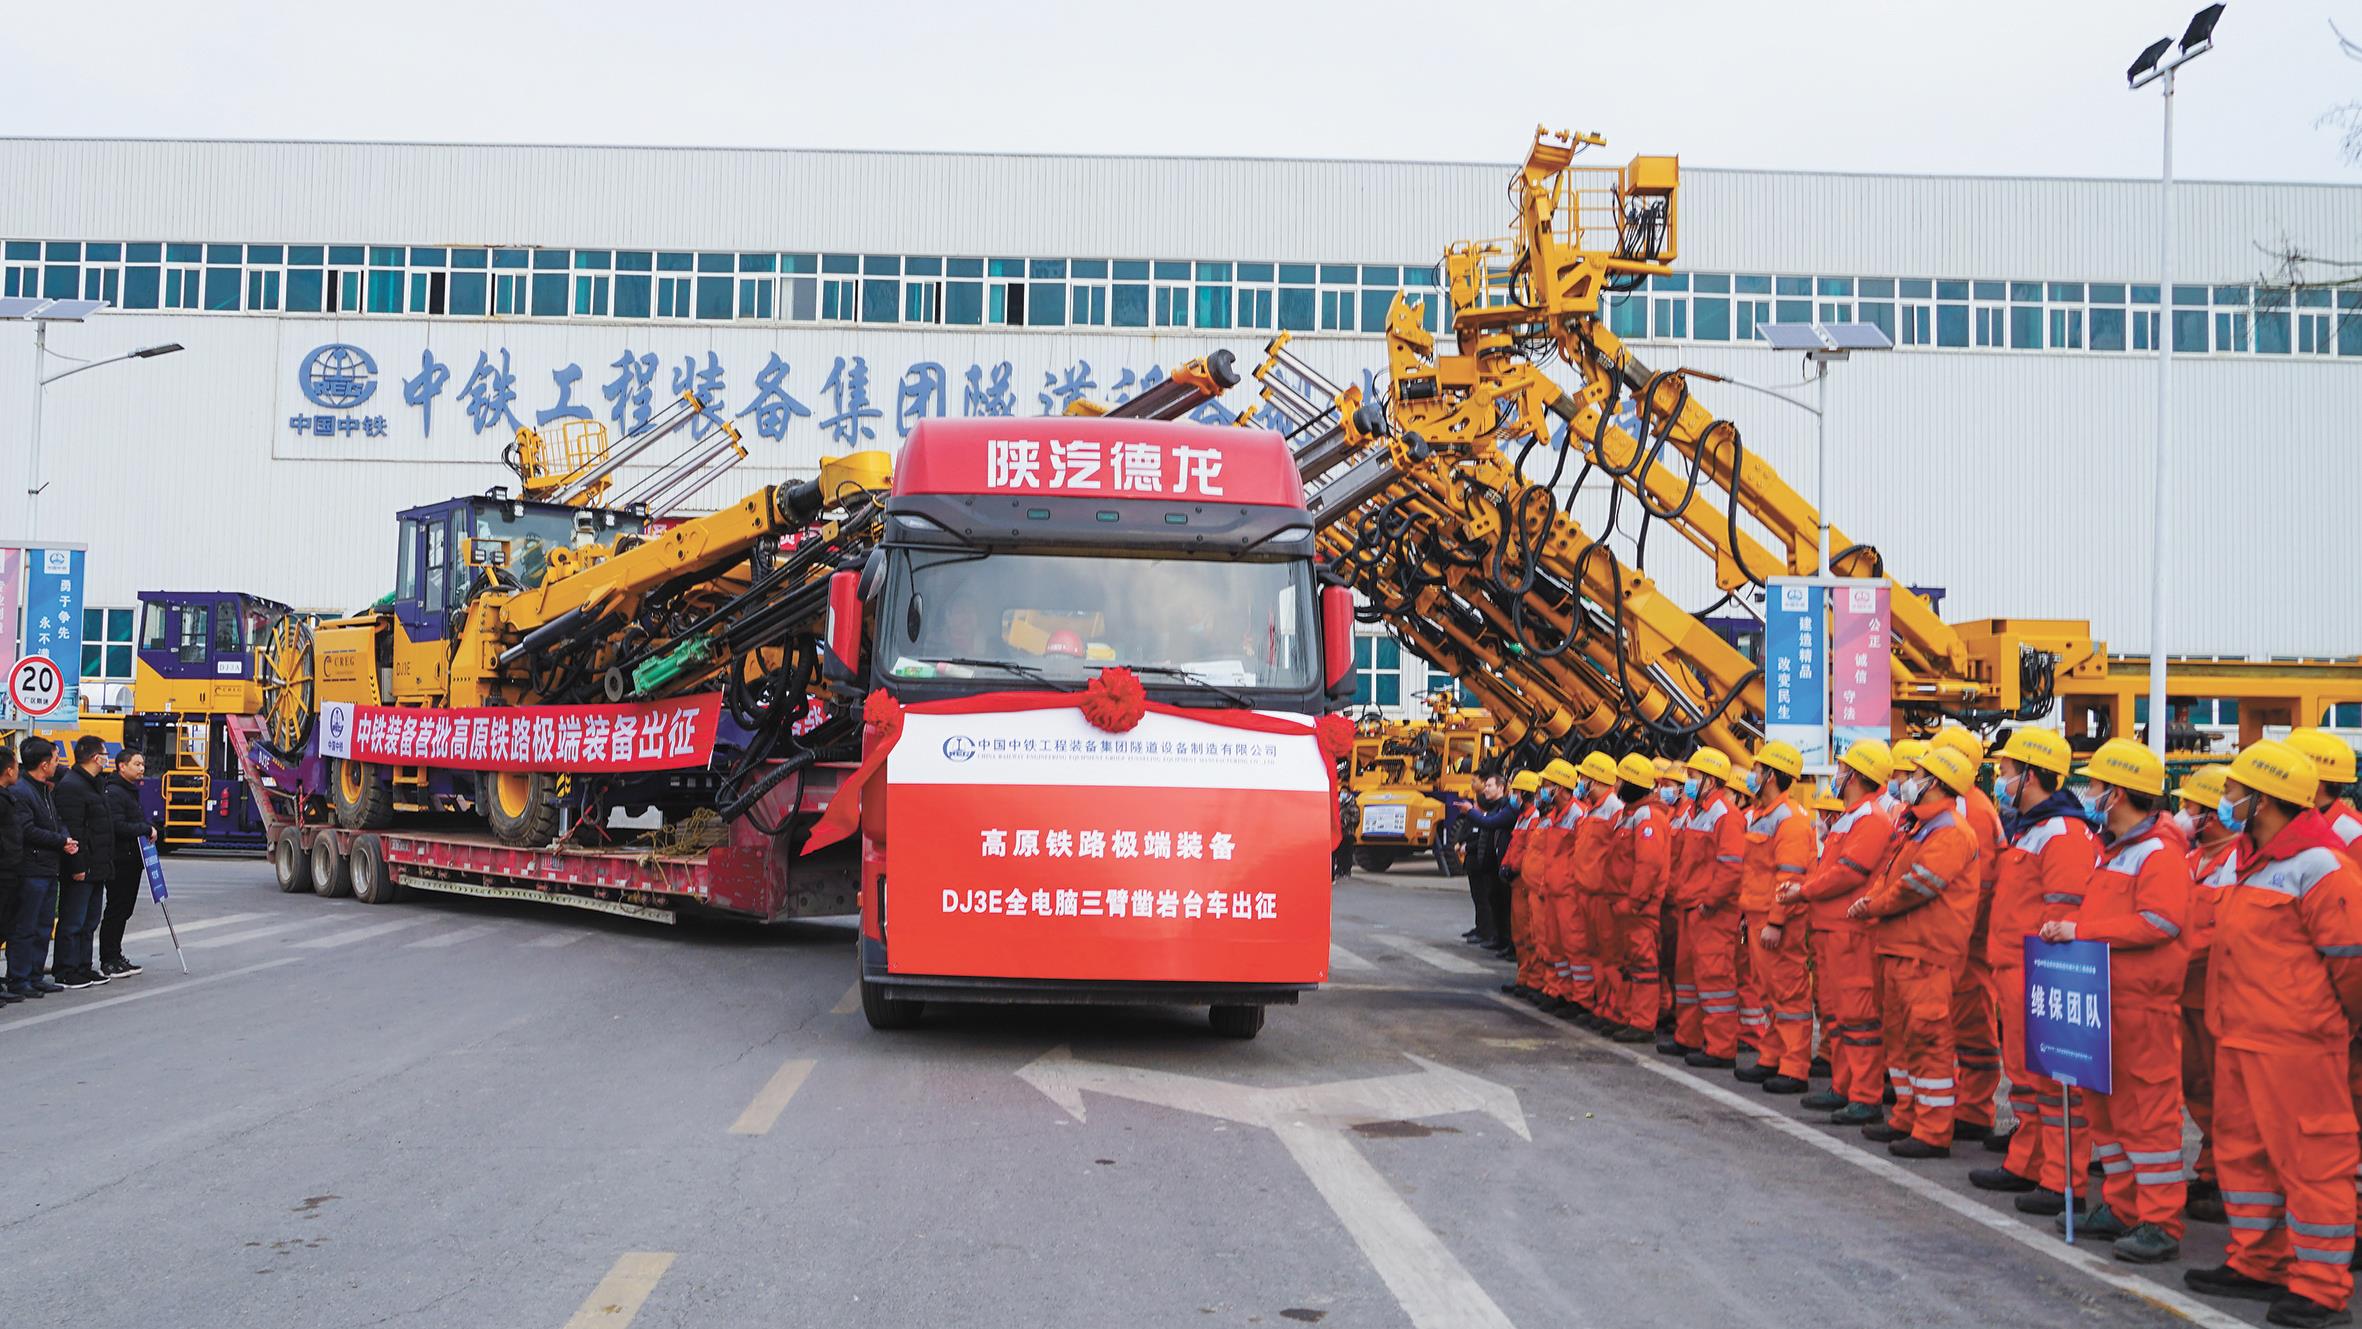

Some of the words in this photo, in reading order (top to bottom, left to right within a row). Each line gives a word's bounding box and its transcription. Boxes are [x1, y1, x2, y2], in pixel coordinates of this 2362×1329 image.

[289, 413, 388, 438] 中国中铁
[987, 439, 1224, 497] 陕汽德龙
[58, 579, 71, 639] 勇于争先
[1799, 616, 1812, 679] 建造精品
[1868, 617, 1881, 648] 公正
[22, 666, 53, 692] 20
[1855, 653, 1868, 684] 诚信
[1777, 656, 1791, 720] 改变民生
[1843, 689, 1856, 721] 守法
[357, 707, 700, 764] 中铁装备首批高原铁路极端装备出征
[978, 738, 1277, 757] 中国中铁工程装备集团隧道设备制造有限公司
[980, 829, 1236, 860] 高原铁路极端装备
[942, 887, 1278, 920] DJ3E全电脑三臂凿岩台车出征
[2031, 983, 2101, 1029] 维保团队
